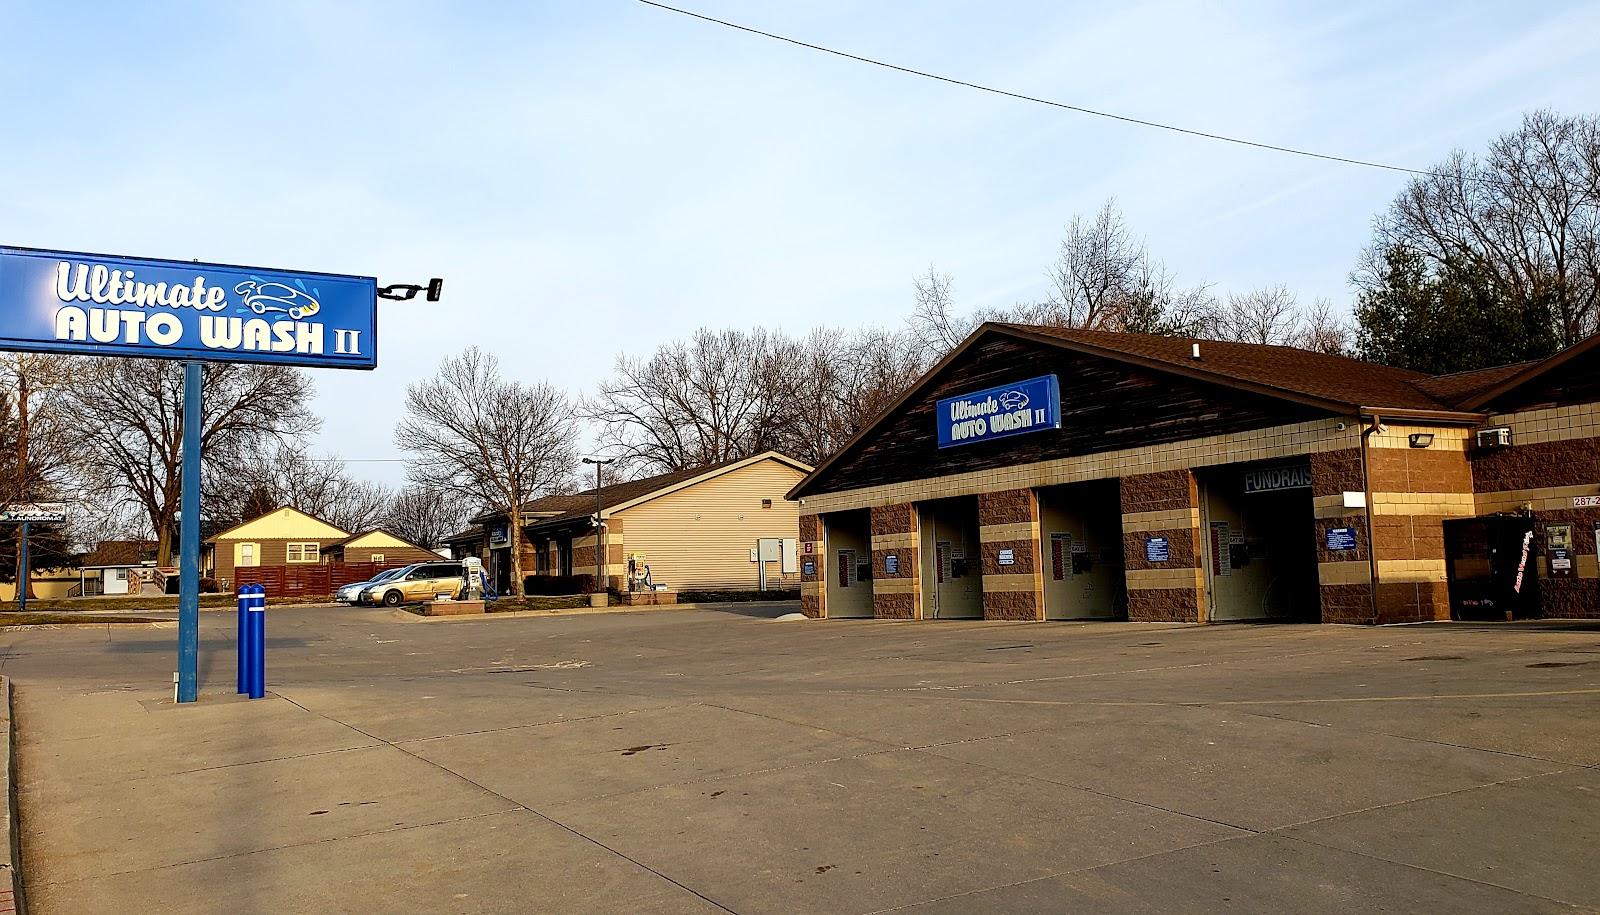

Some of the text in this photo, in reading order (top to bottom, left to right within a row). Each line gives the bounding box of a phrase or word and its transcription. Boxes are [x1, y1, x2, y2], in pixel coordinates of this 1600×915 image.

[56, 261, 228, 312] Ultimate
[55, 306, 363, 356] AUTO WASH II
[950, 395, 999, 422] Ultimate
[951, 408, 1046, 441] AUTO WASH II
